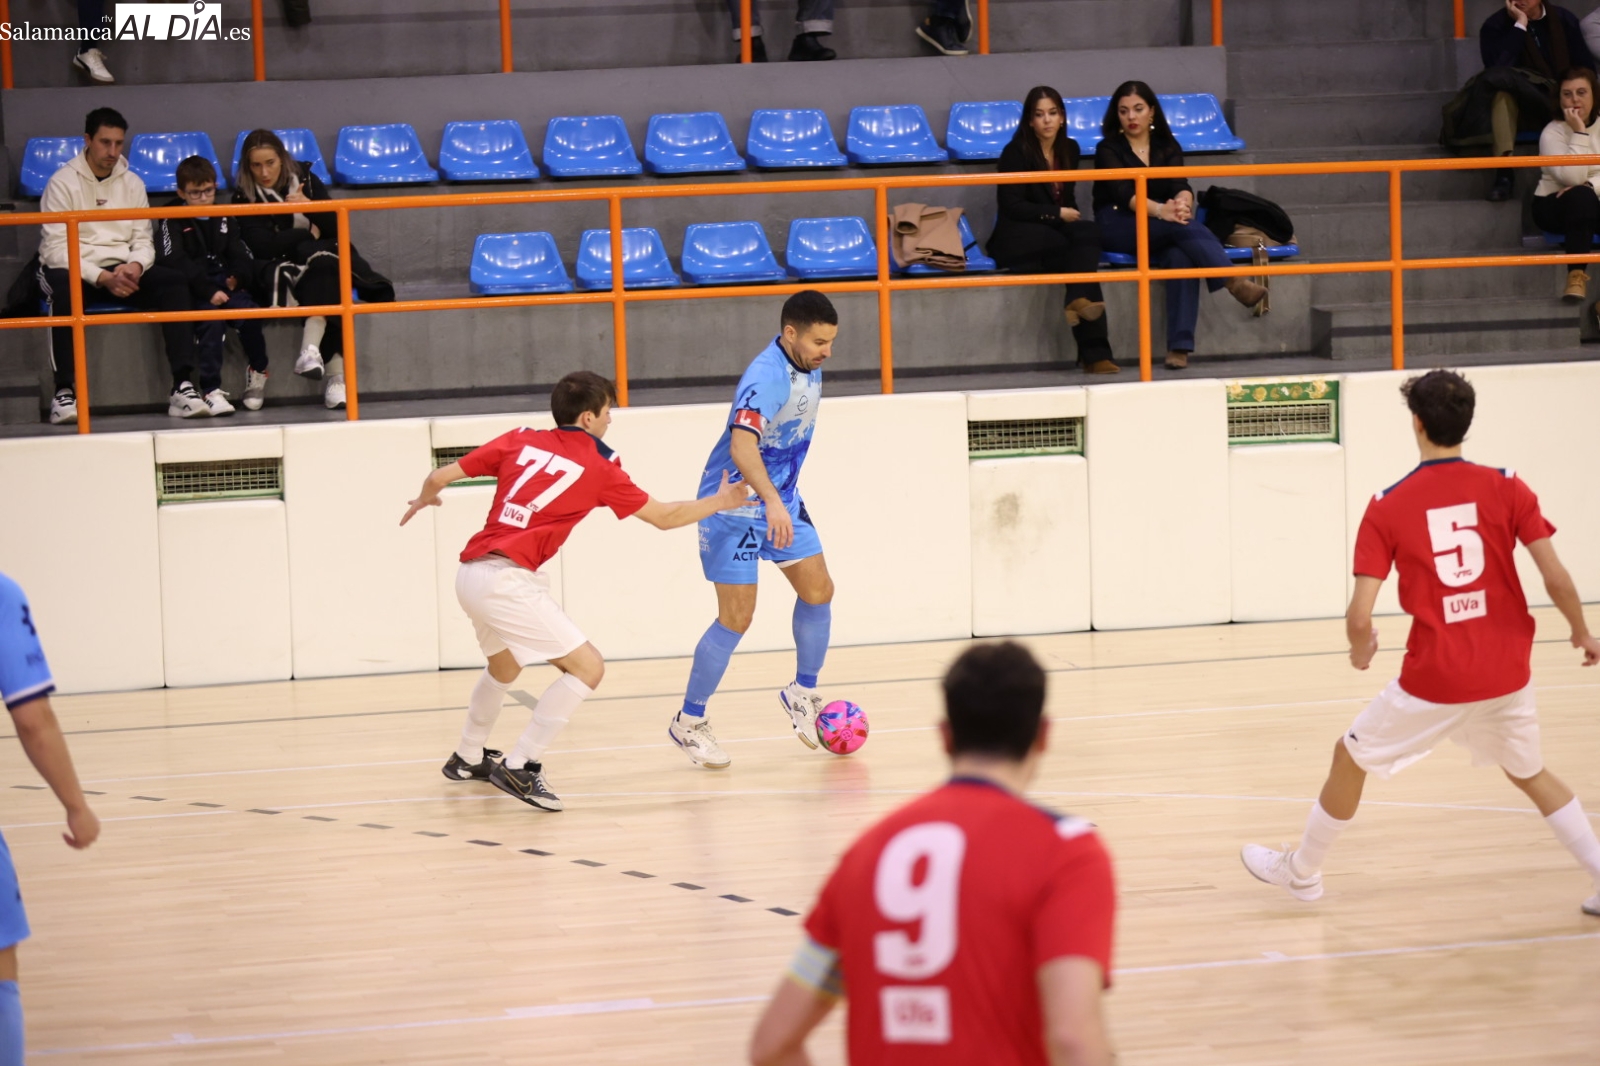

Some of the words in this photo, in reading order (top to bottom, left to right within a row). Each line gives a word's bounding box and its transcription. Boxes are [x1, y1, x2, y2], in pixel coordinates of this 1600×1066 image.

[503, 445, 585, 513] 77
[503, 506, 525, 523] UVa
[1426, 502, 1485, 588] 5
[1450, 597, 1479, 614] UVa
[874, 821, 966, 981] 9
